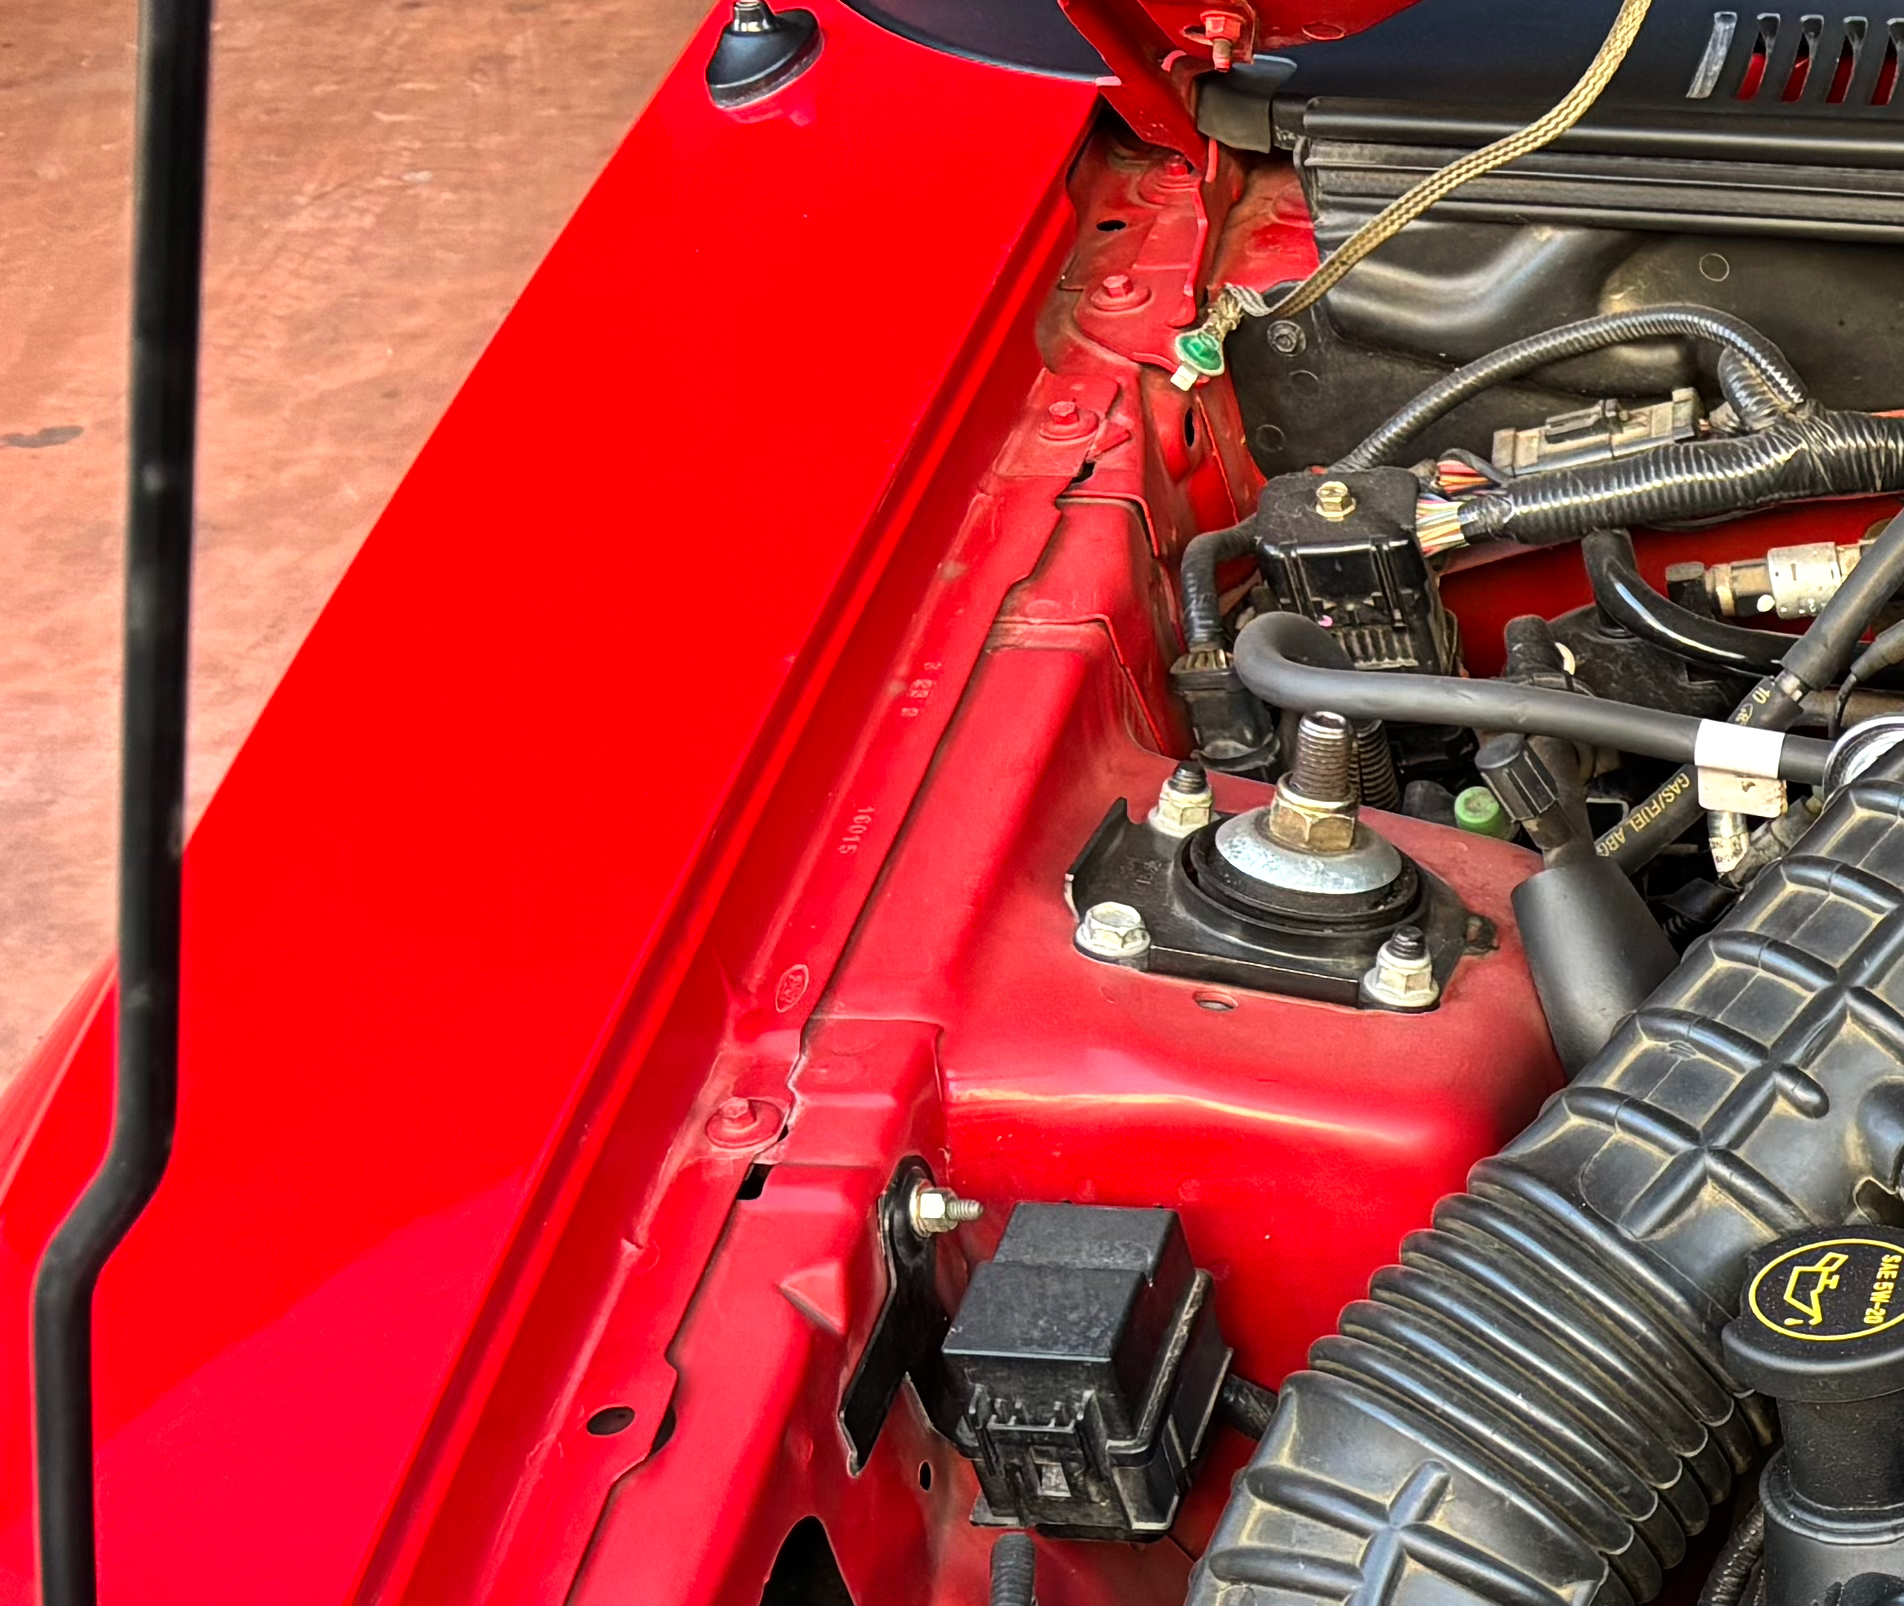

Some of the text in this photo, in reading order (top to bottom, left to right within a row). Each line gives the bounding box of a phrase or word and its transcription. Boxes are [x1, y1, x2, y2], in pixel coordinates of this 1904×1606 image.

[1629, 772, 1691, 833] GAS/FUEL
[1863, 1254, 1903, 1325] SAE 5W-20
